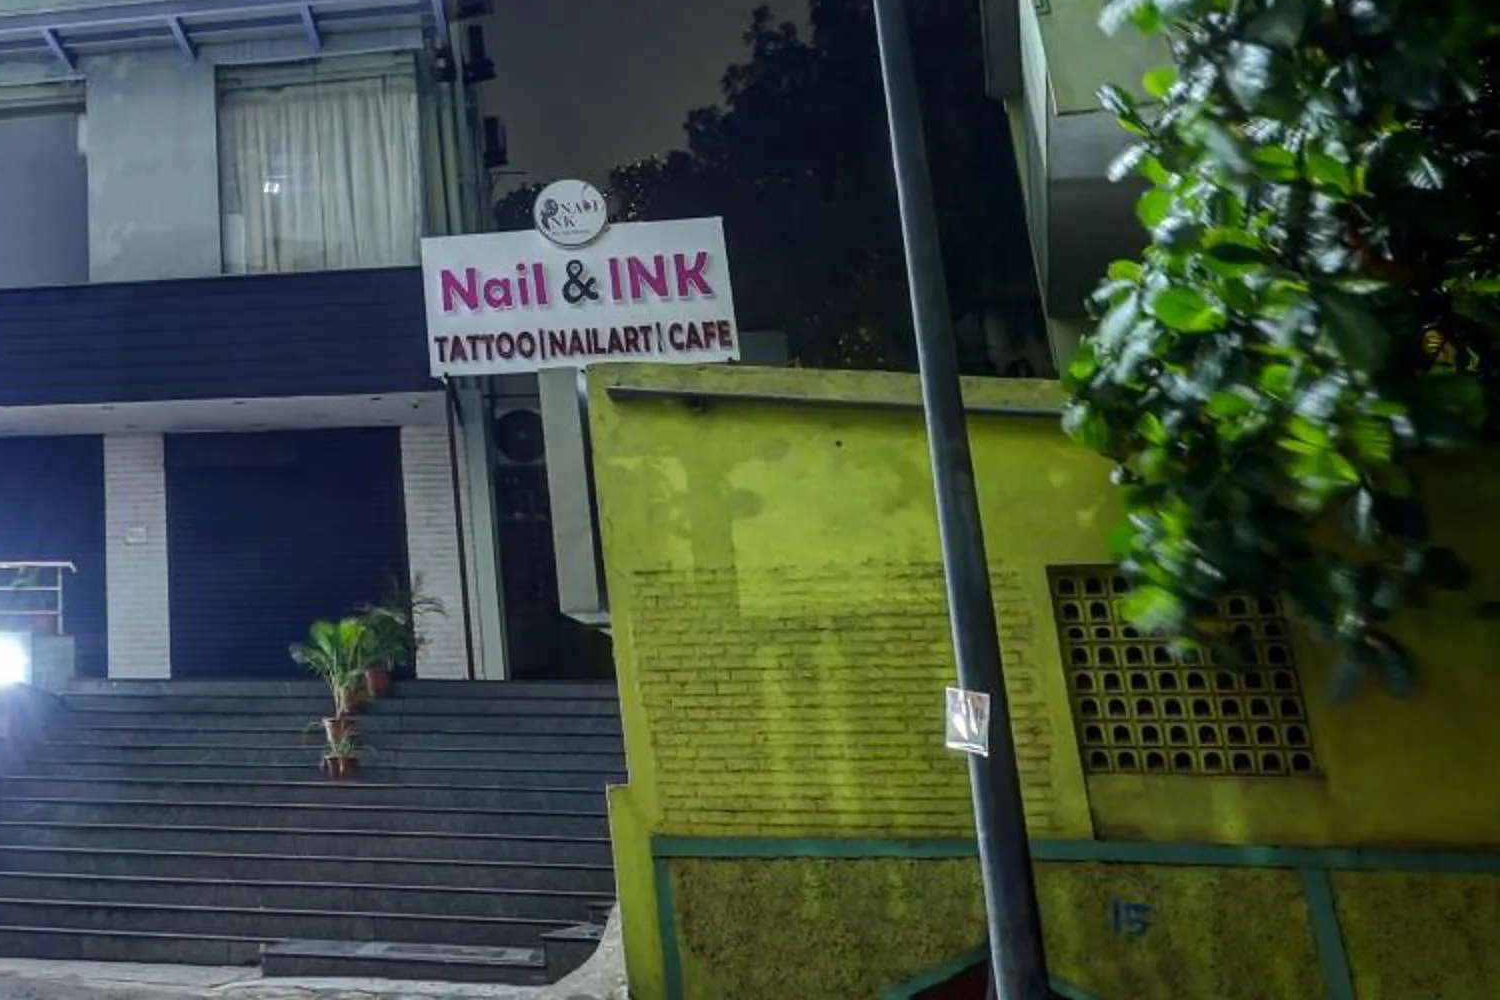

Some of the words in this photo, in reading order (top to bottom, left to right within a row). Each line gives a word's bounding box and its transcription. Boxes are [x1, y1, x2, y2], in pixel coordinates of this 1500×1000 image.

[440, 261, 549, 313] Nail
[561, 259, 599, 304] &
[608, 251, 713, 301] INK
[668, 319, 734, 350] CAFE
